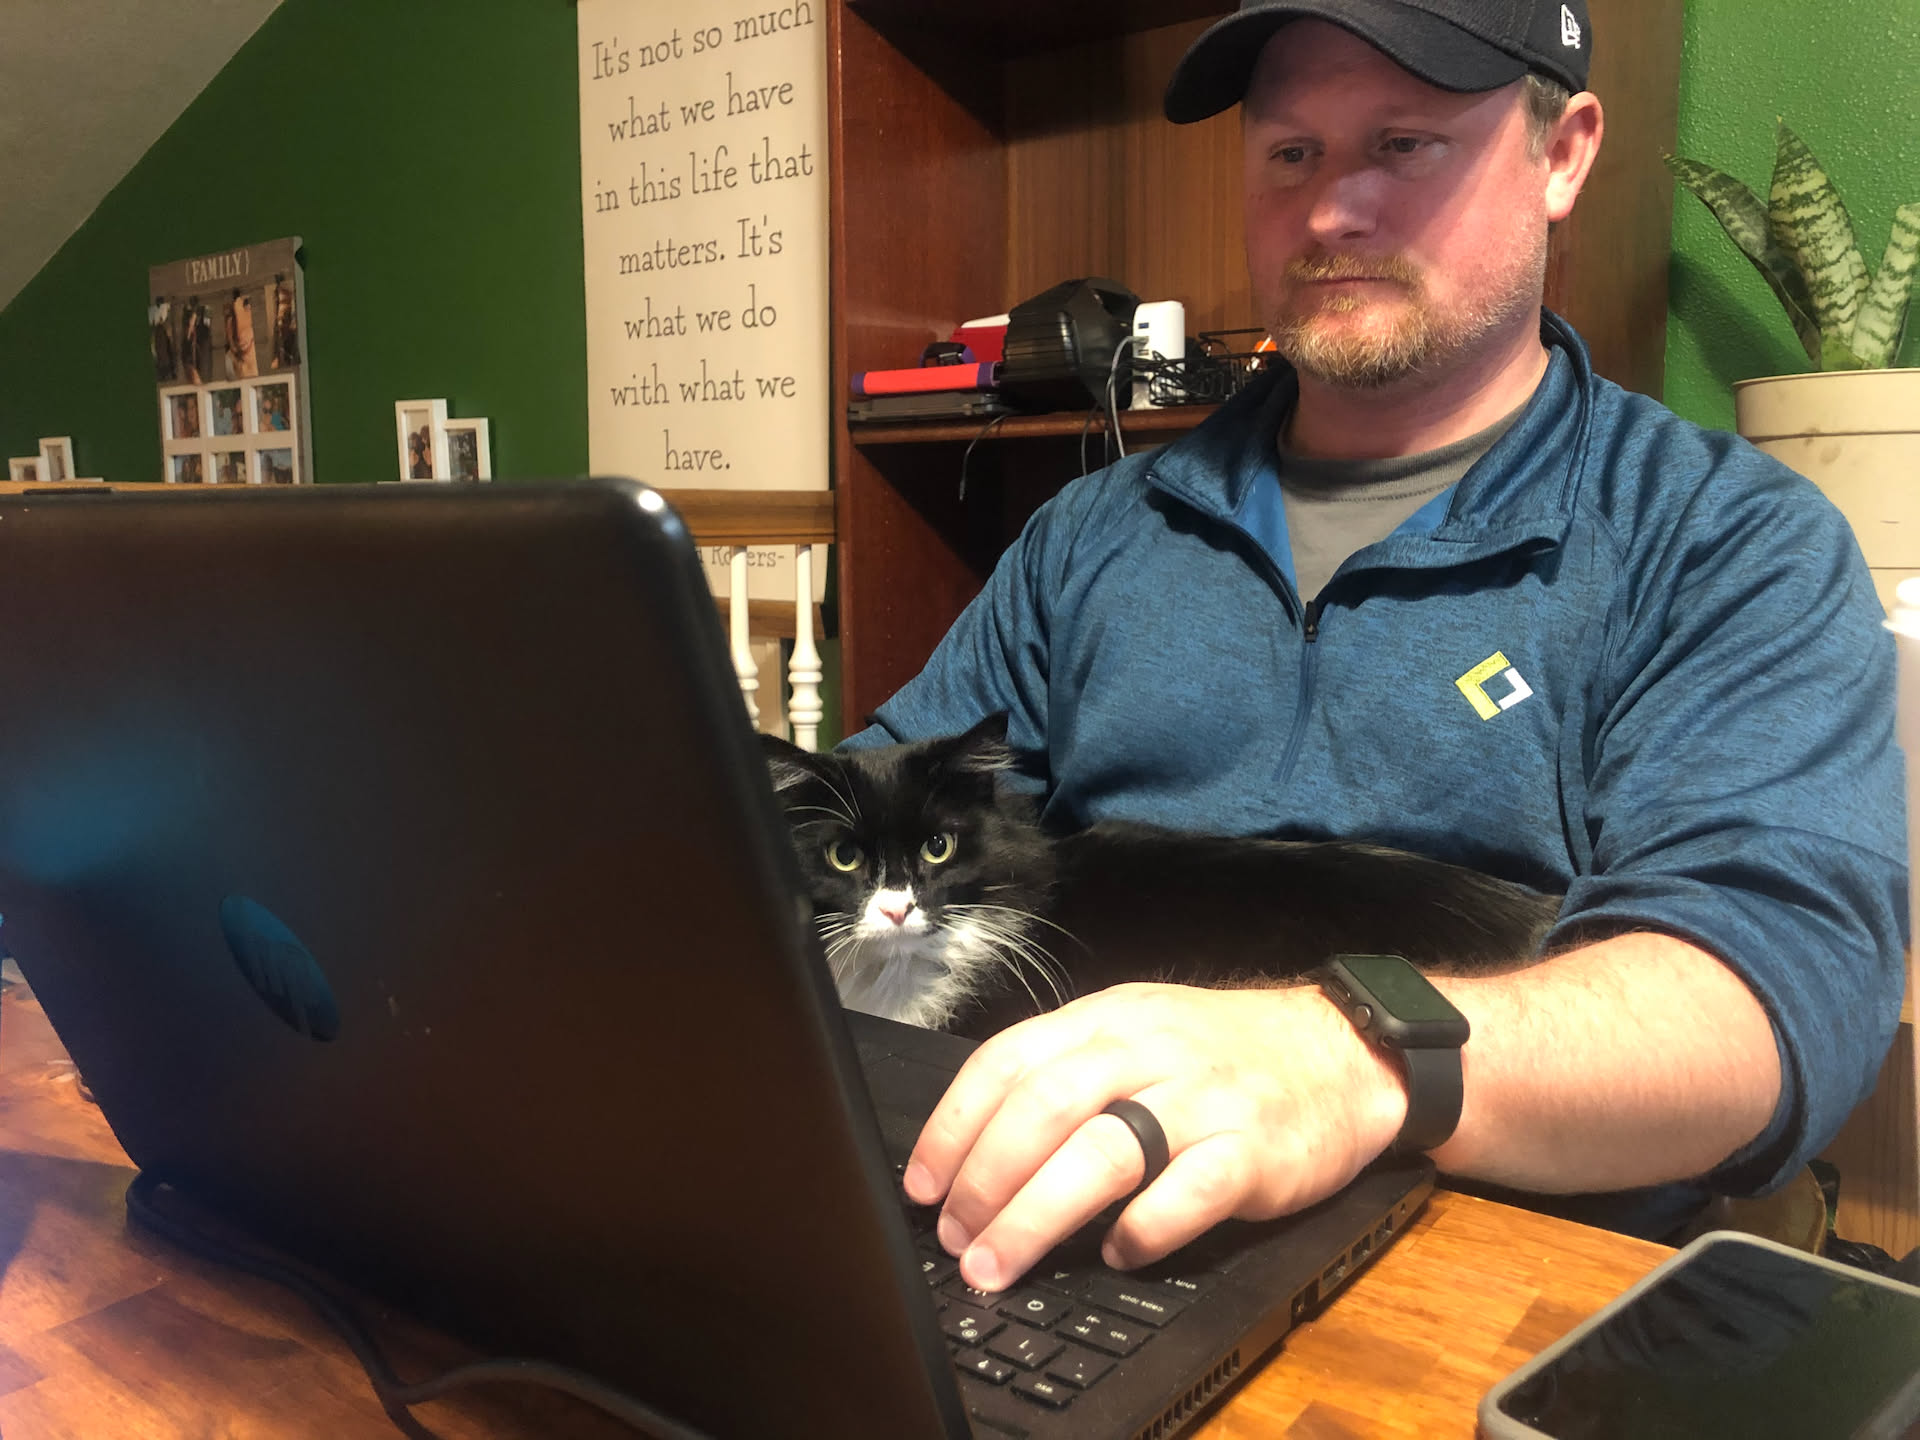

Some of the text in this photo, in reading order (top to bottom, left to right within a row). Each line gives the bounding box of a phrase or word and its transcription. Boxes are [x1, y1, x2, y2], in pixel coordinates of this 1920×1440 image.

[592, 0, 815, 80] It's not so much
[608, 71, 794, 142] what we have
[595, 136, 814, 213] in this life that
[619, 215, 784, 275] matters. It's
[624, 284, 777, 340] what we do
[610, 358, 797, 407] with what we
[663, 428, 731, 471] have.
[711, 546, 785, 568] Roers-
